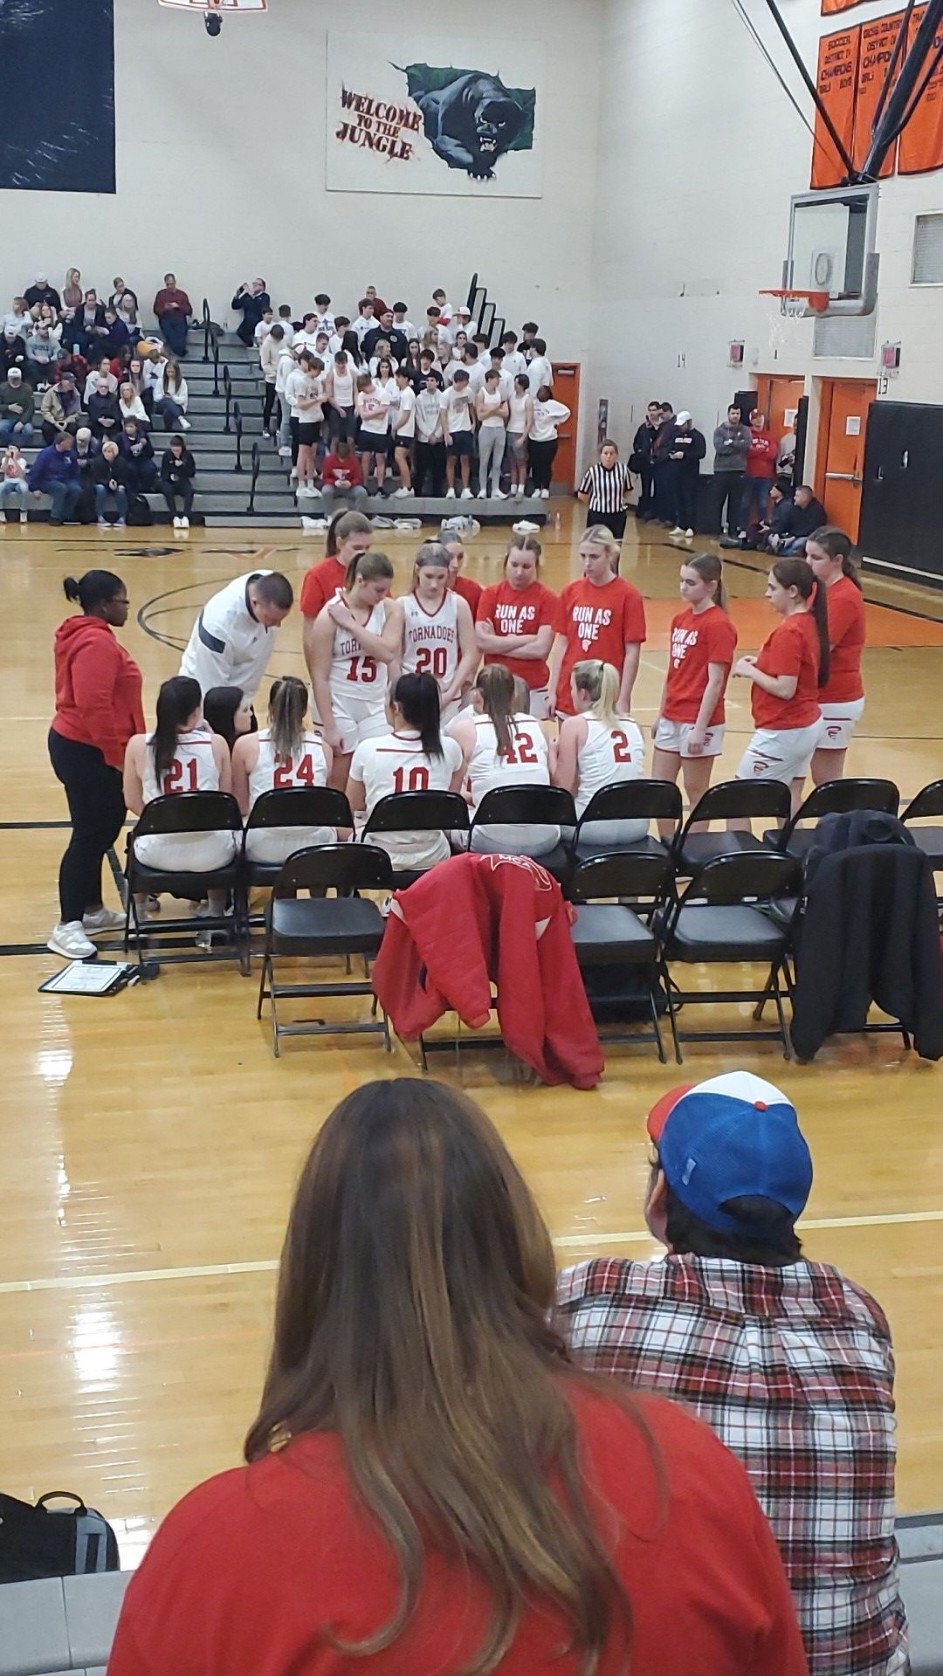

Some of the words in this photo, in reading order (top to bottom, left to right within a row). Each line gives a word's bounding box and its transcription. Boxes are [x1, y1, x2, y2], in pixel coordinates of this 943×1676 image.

[341, 87, 422, 133] WELCOME
[357, 114, 373, 129] TO
[376, 120, 400, 139] THE
[336, 121, 412, 160] JUNGLE
[494, 603, 518, 619] RUN
[519, 605, 536, 621] AS
[572, 605, 594, 623] RUN
[594, 607, 612, 626] AS
[500, 618, 524, 634] ONE
[578, 622, 600, 640] ONE
[684, 630, 699, 646] AS
[415, 647, 448, 679] 20
[671, 643, 688, 659] ONE
[346, 655, 377, 683] 15
[611, 731, 632, 763] 2
[163, 757, 200, 794] 21
[273, 753, 315, 788] 24
[392, 766, 430, 793] 10
